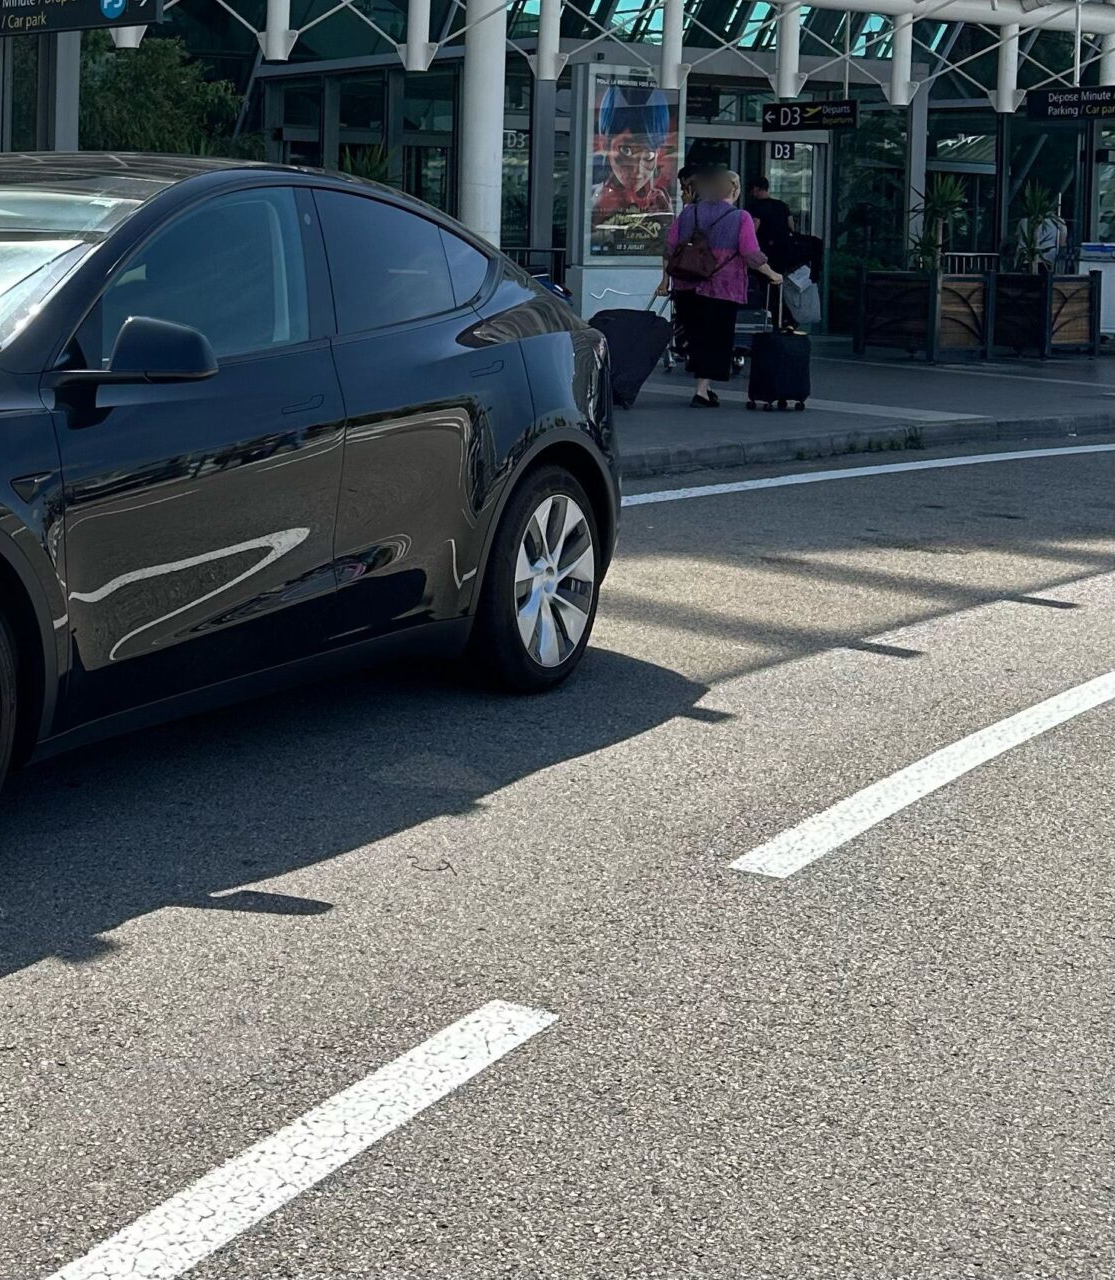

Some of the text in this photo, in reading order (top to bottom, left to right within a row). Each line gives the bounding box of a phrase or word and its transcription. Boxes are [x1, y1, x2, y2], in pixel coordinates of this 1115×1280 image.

[7, 15, 24, 28] Car
[25, 11, 47, 29] park
[1048, 93, 1078, 104] Dépose
[1081, 91, 1111, 100] Minute
[780, 107, 800, 126] D3
[822, 105, 851, 115] Départs
[1048, 105, 1078, 117] Parking
[1086, 105, 1100, 114] Car
[507, 132, 525, 148] D3
[775, 143, 790, 159] D3
